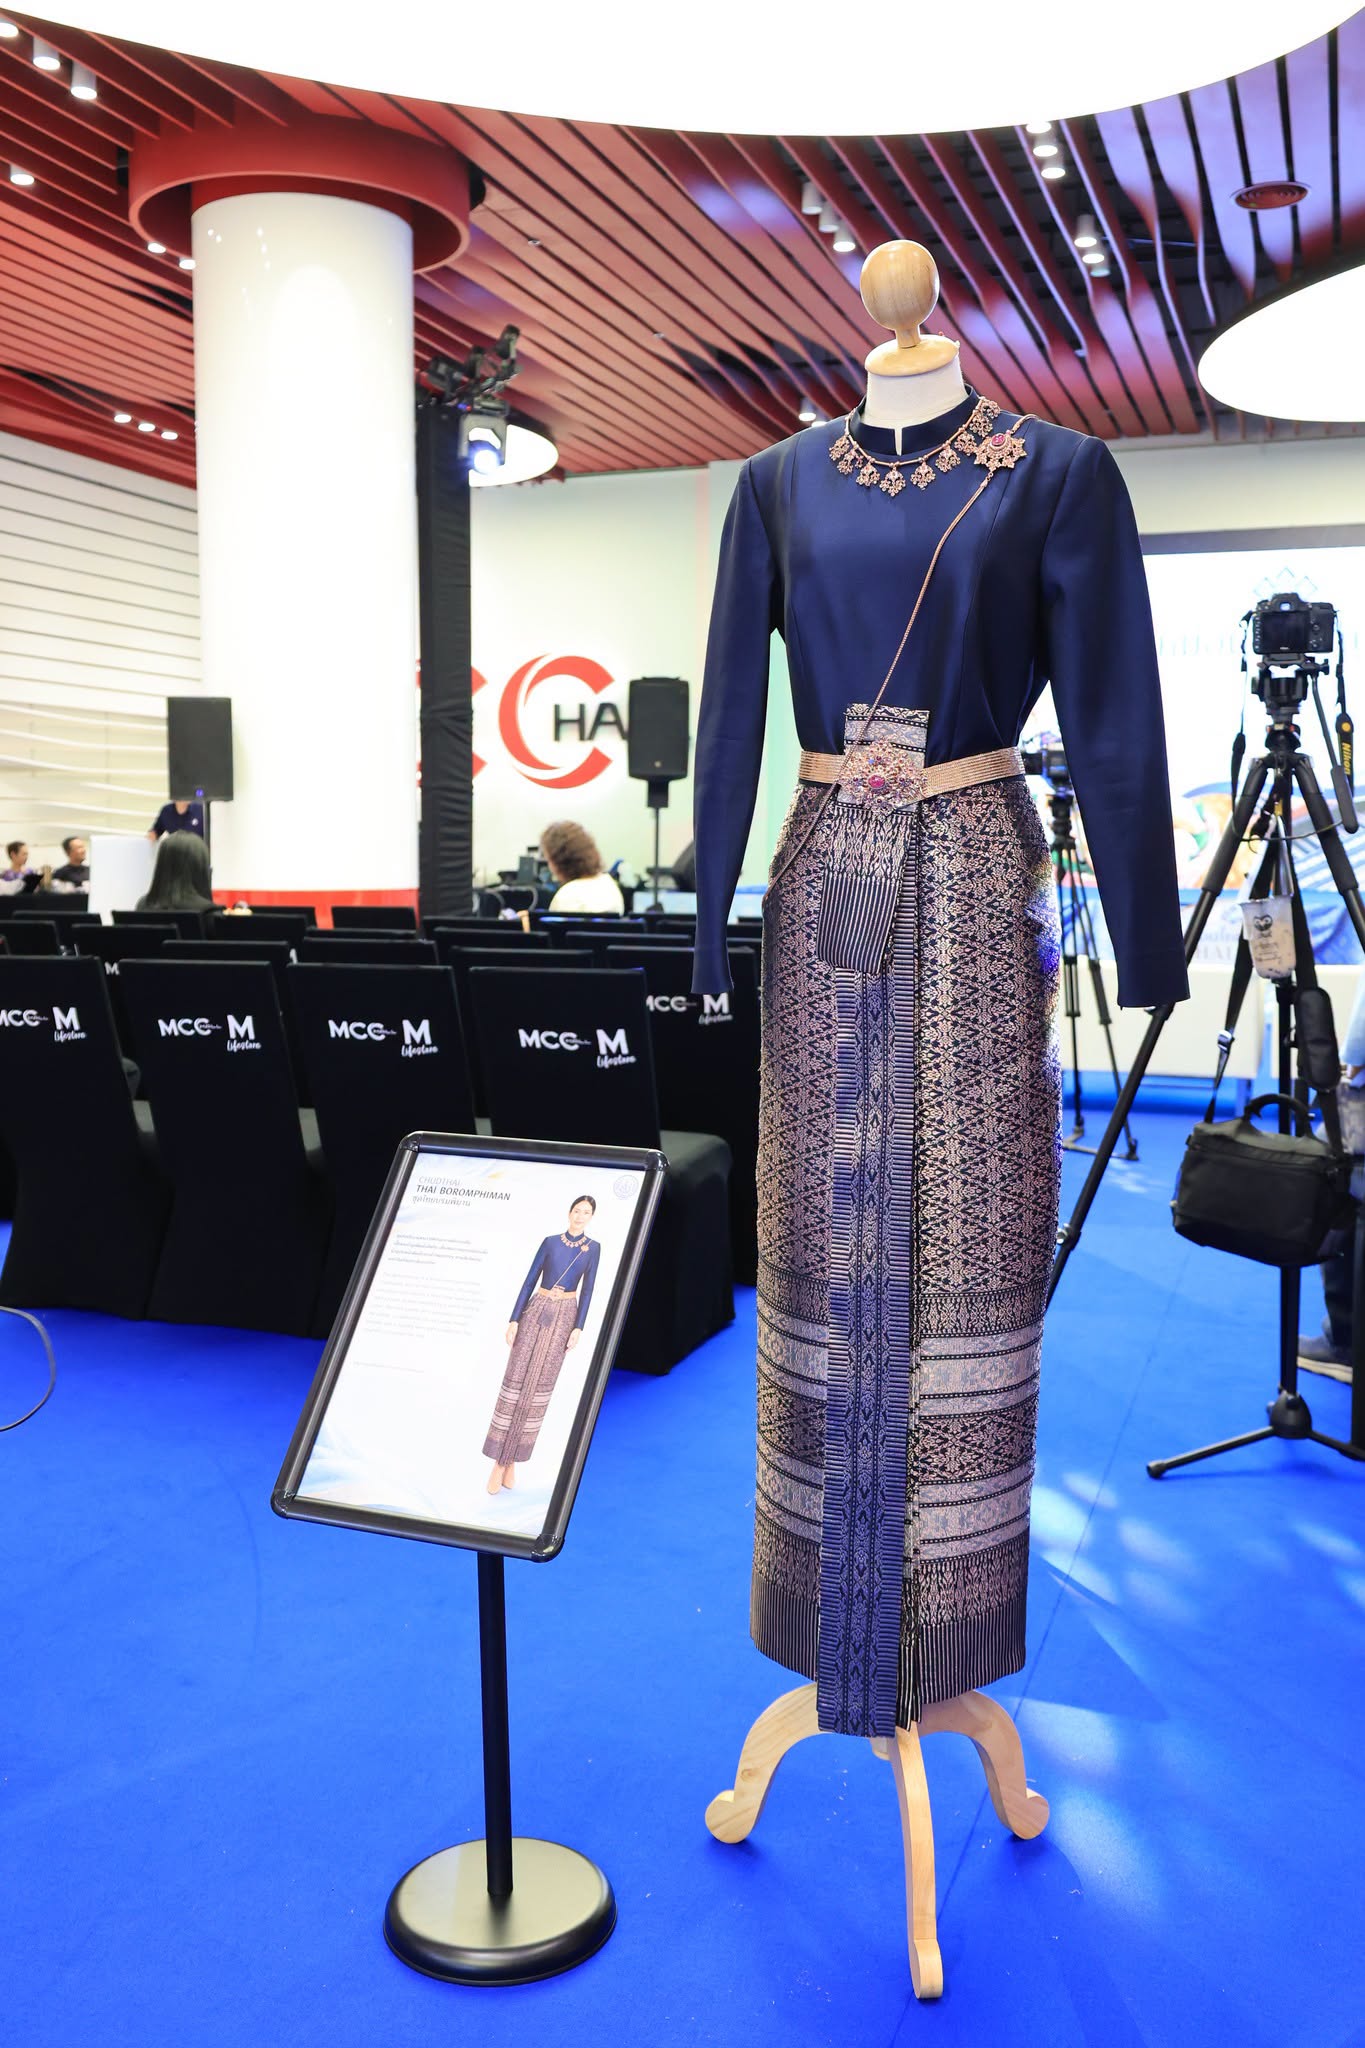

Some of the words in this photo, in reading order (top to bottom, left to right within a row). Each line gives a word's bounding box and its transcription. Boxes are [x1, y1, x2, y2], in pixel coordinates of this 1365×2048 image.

[1342, 742, 1352, 775] Nikon
[703, 992, 729, 1014] M
[53, 1007, 80, 1030] M
[227, 1015, 256, 1040] M
[402, 1019, 432, 1045] M
[596, 1028, 629, 1055] M
[416, 1184, 437, 1194] THAI
[439, 1186, 511, 1201] BOROMPHIMAN
